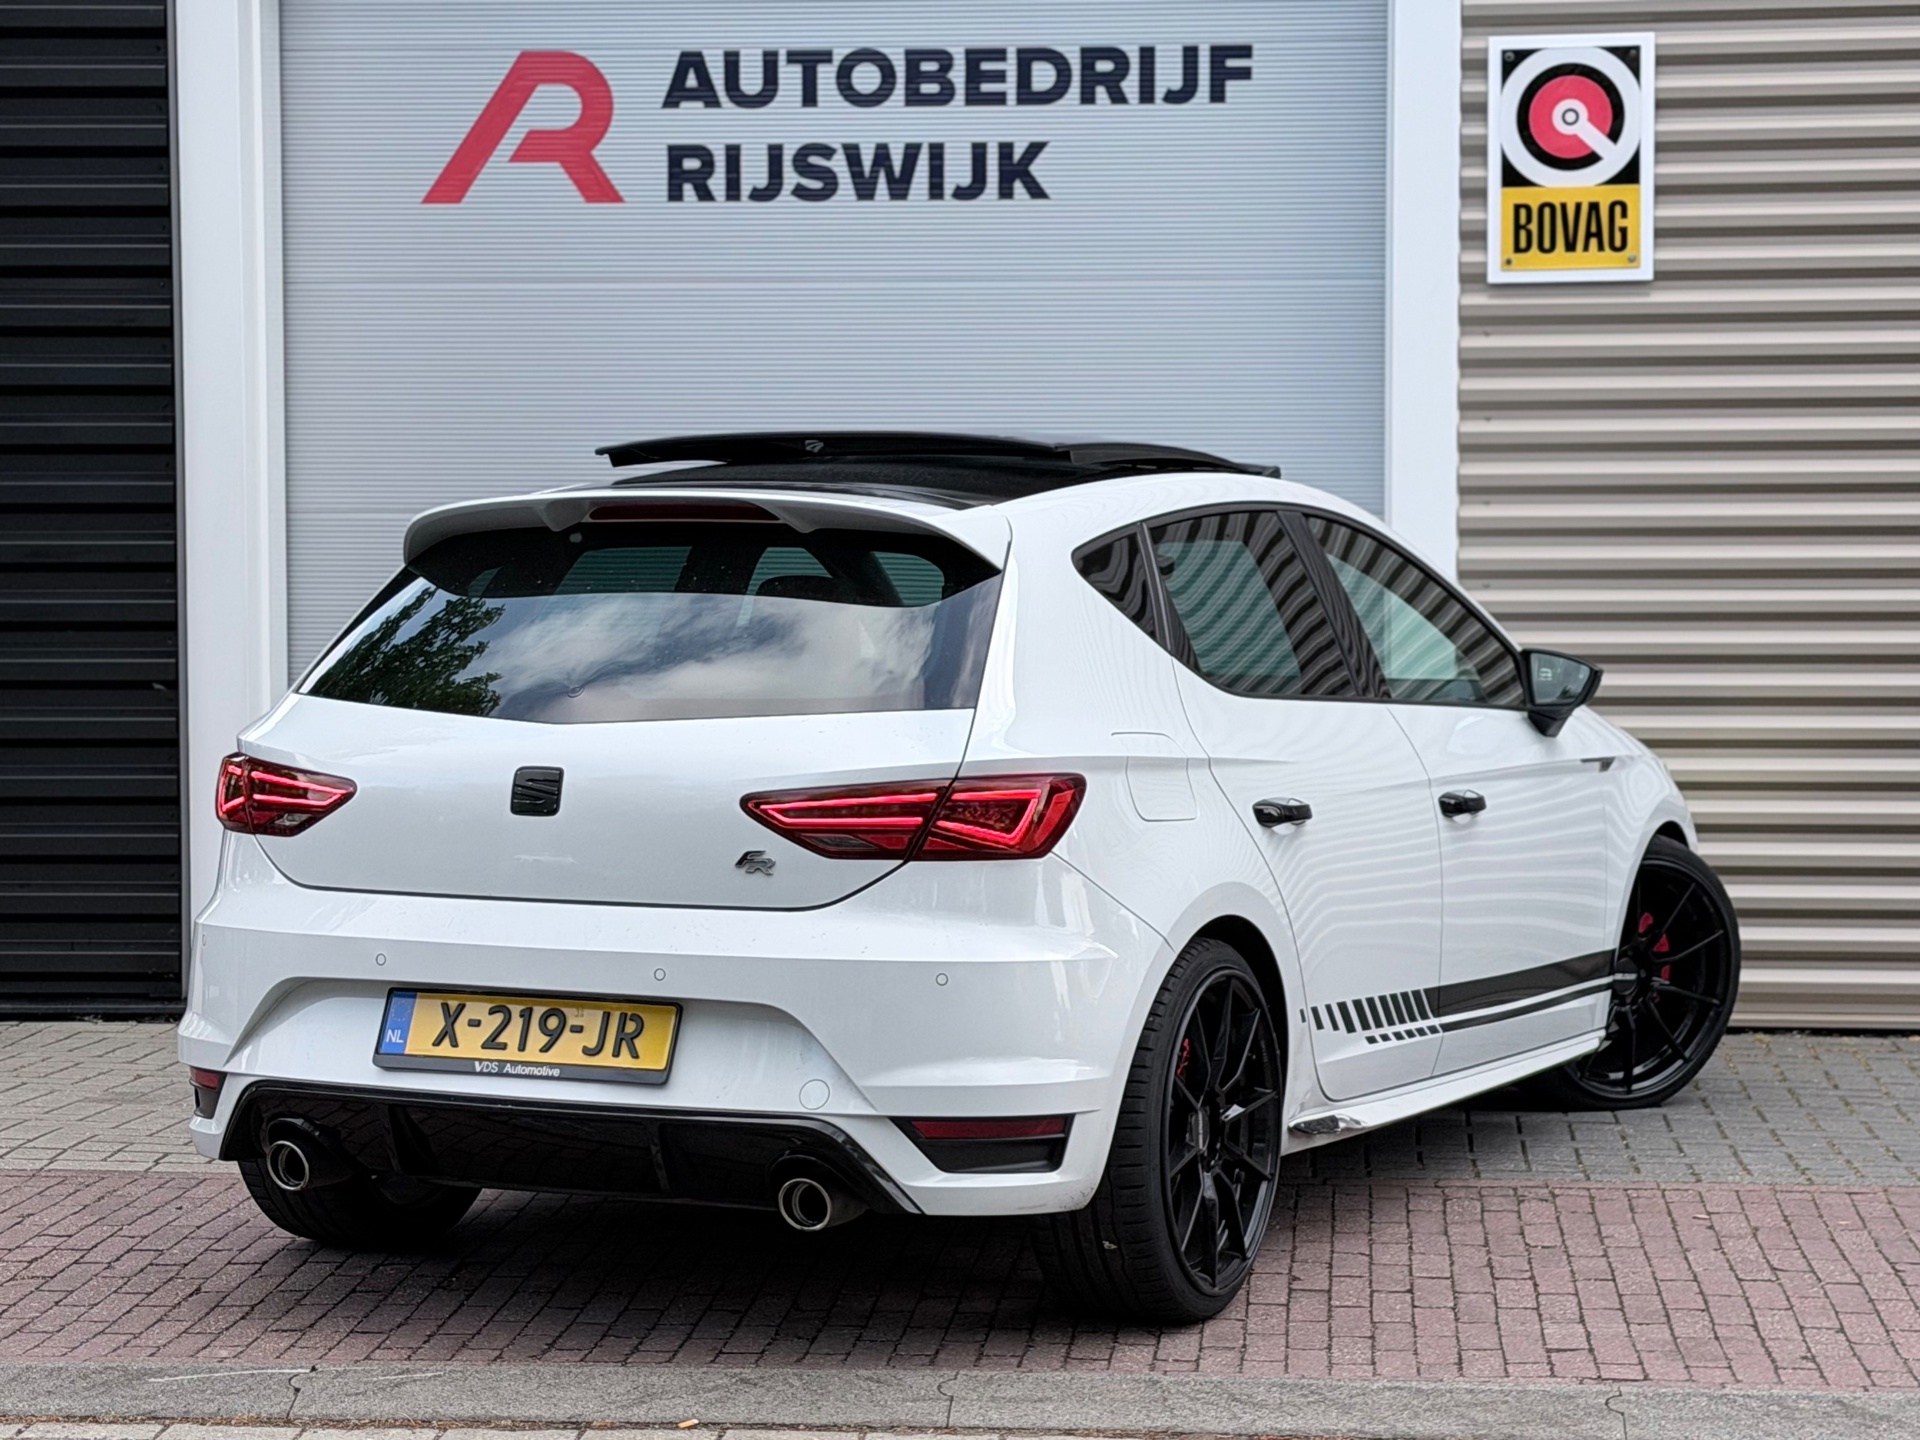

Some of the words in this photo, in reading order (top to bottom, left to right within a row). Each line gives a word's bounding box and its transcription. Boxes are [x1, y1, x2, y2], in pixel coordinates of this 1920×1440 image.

[662, 44, 1254, 109] AUTOBEDRIJF
[666, 141, 1051, 204] RIJSWIJK
[1513, 200, 1628, 254] BOVAG
[386, 1029, 404, 1043] NL
[431, 1001, 644, 1060] X-219-JR
[474, 1061, 499, 1073] VDS
[503, 1063, 560, 1077] Automotive
